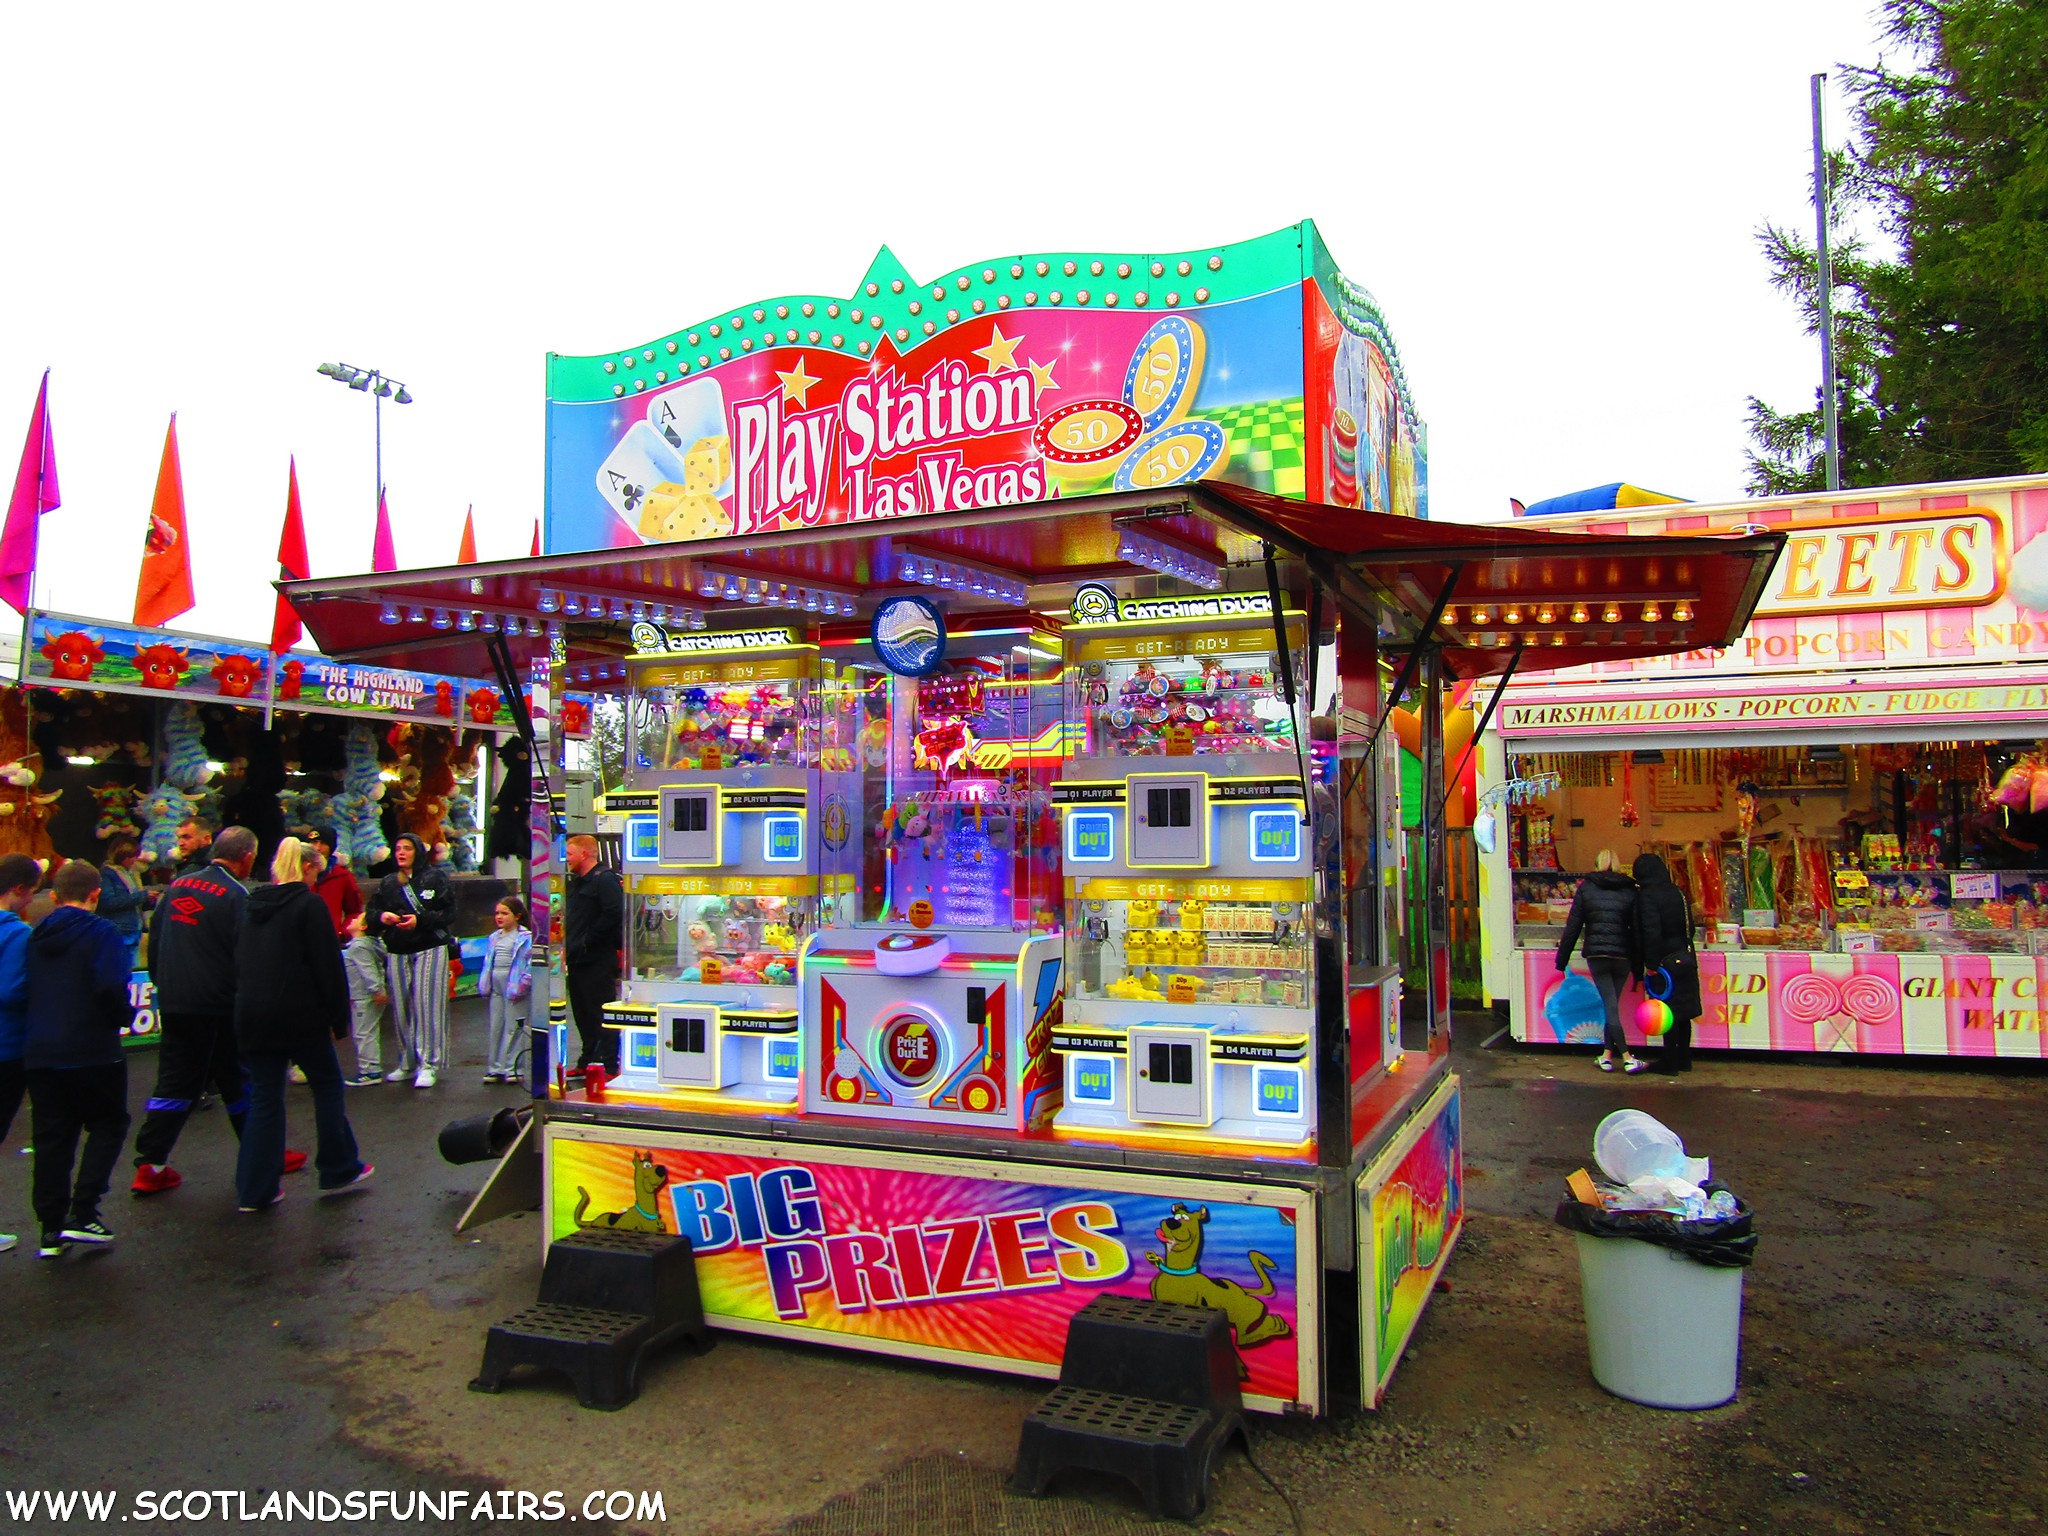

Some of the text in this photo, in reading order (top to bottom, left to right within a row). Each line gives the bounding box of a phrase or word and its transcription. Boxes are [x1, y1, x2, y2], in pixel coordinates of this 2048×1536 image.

[1142, 353, 1173, 399] 50
[660, 400, 677, 425] A
[1066, 419, 1109, 446] 50
[735, 365, 1033, 530] Play Station
[1146, 445, 1190, 482] 50
[607, 469, 627, 492] A
[853, 457, 1040, 520] Las Vegas
[1123, 598, 1220, 620] CATCHING
[667, 629, 792, 652] CATCHING DUCK
[1744, 628, 1910, 658] POPCORN
[320, 665, 349, 685] THE
[325, 685, 415, 711] COW STALL
[1511, 701, 1718, 725] MARSHMALLOWS
[1737, 695, 1863, 717] POPCORN
[1884, 691, 1982, 712] FUDGE
[743, 796, 769, 804] PLAYER
[1082, 789, 1113, 798] PLAYER
[1238, 786, 1271, 795] PLAYER
[626, 798, 650, 807] PLAYER
[774, 834, 798, 848] OUT
[1079, 831, 1107, 846] OUT
[1261, 830, 1291, 845] OUT
[1903, 977, 2004, 998] GIANT
[625, 1014, 649, 1022] PLAYER
[742, 1020, 767, 1029] PLAYER
[1083, 1038, 1114, 1048] PLAYER
[1226, 1045, 1273, 1057] 04 PLAYER
[775, 1053, 798, 1067] OUT
[1080, 1071, 1109, 1087] OUT
[1263, 1083, 1295, 1099] OUT
[669, 1166, 826, 1253] BIG
[762, 1200, 1131, 1319] PRIZES
